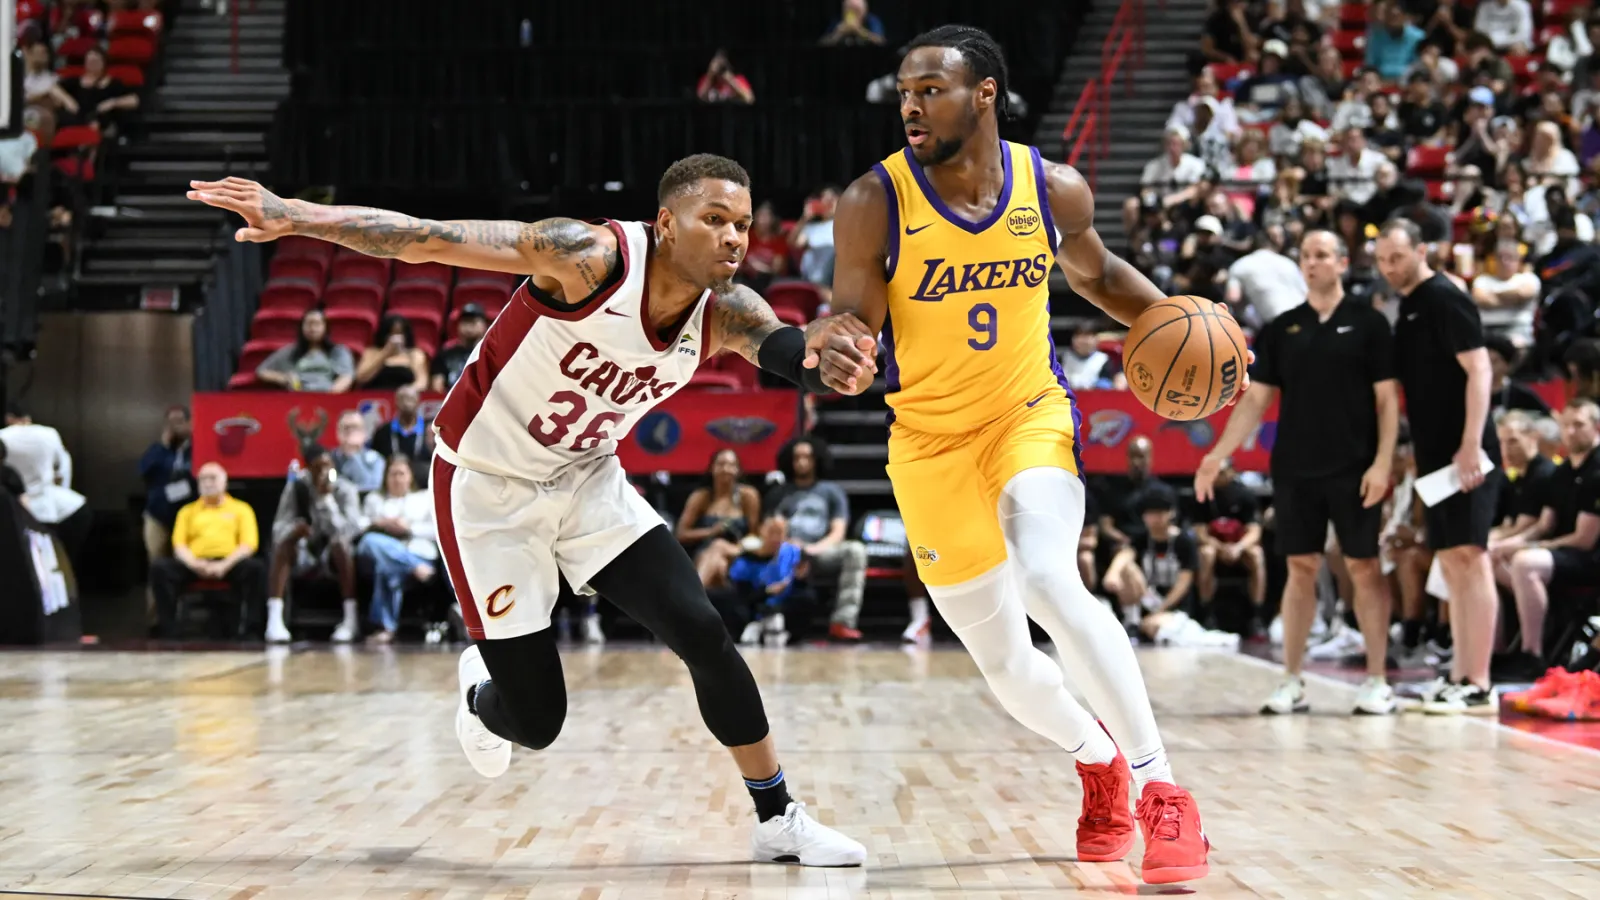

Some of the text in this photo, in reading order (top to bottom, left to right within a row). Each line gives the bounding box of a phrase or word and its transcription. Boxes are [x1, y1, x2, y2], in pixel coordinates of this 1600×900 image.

[1009, 214, 1038, 227] bibigo
[909, 253, 1048, 302] LAKERS
[967, 302, 998, 351] 9
[527, 390, 626, 451] 36
